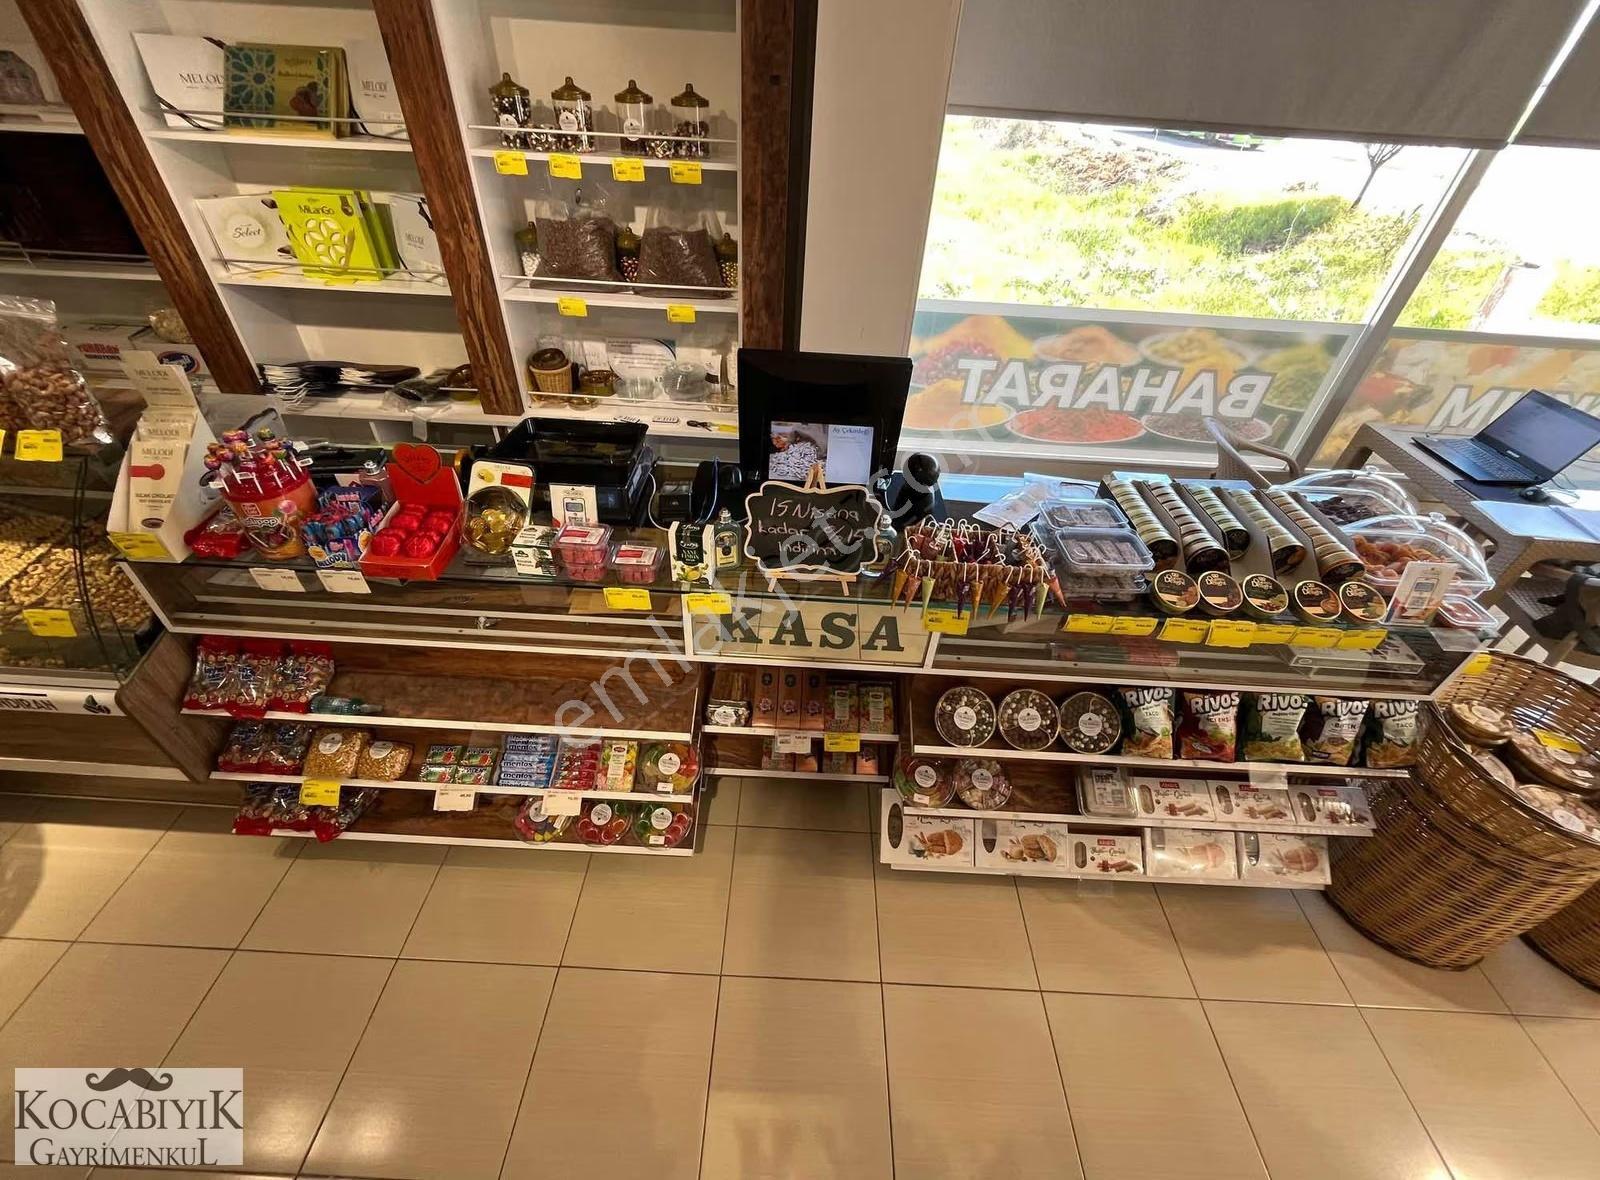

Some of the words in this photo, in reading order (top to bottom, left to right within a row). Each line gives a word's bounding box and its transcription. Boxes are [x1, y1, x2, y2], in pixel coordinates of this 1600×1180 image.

[179, 72, 224, 84] MELOD
[232, 227, 261, 238] Select
[770, 497, 792, 516] 15
[758, 519, 810, 537] kadar
[715, 606, 904, 651] KASA
